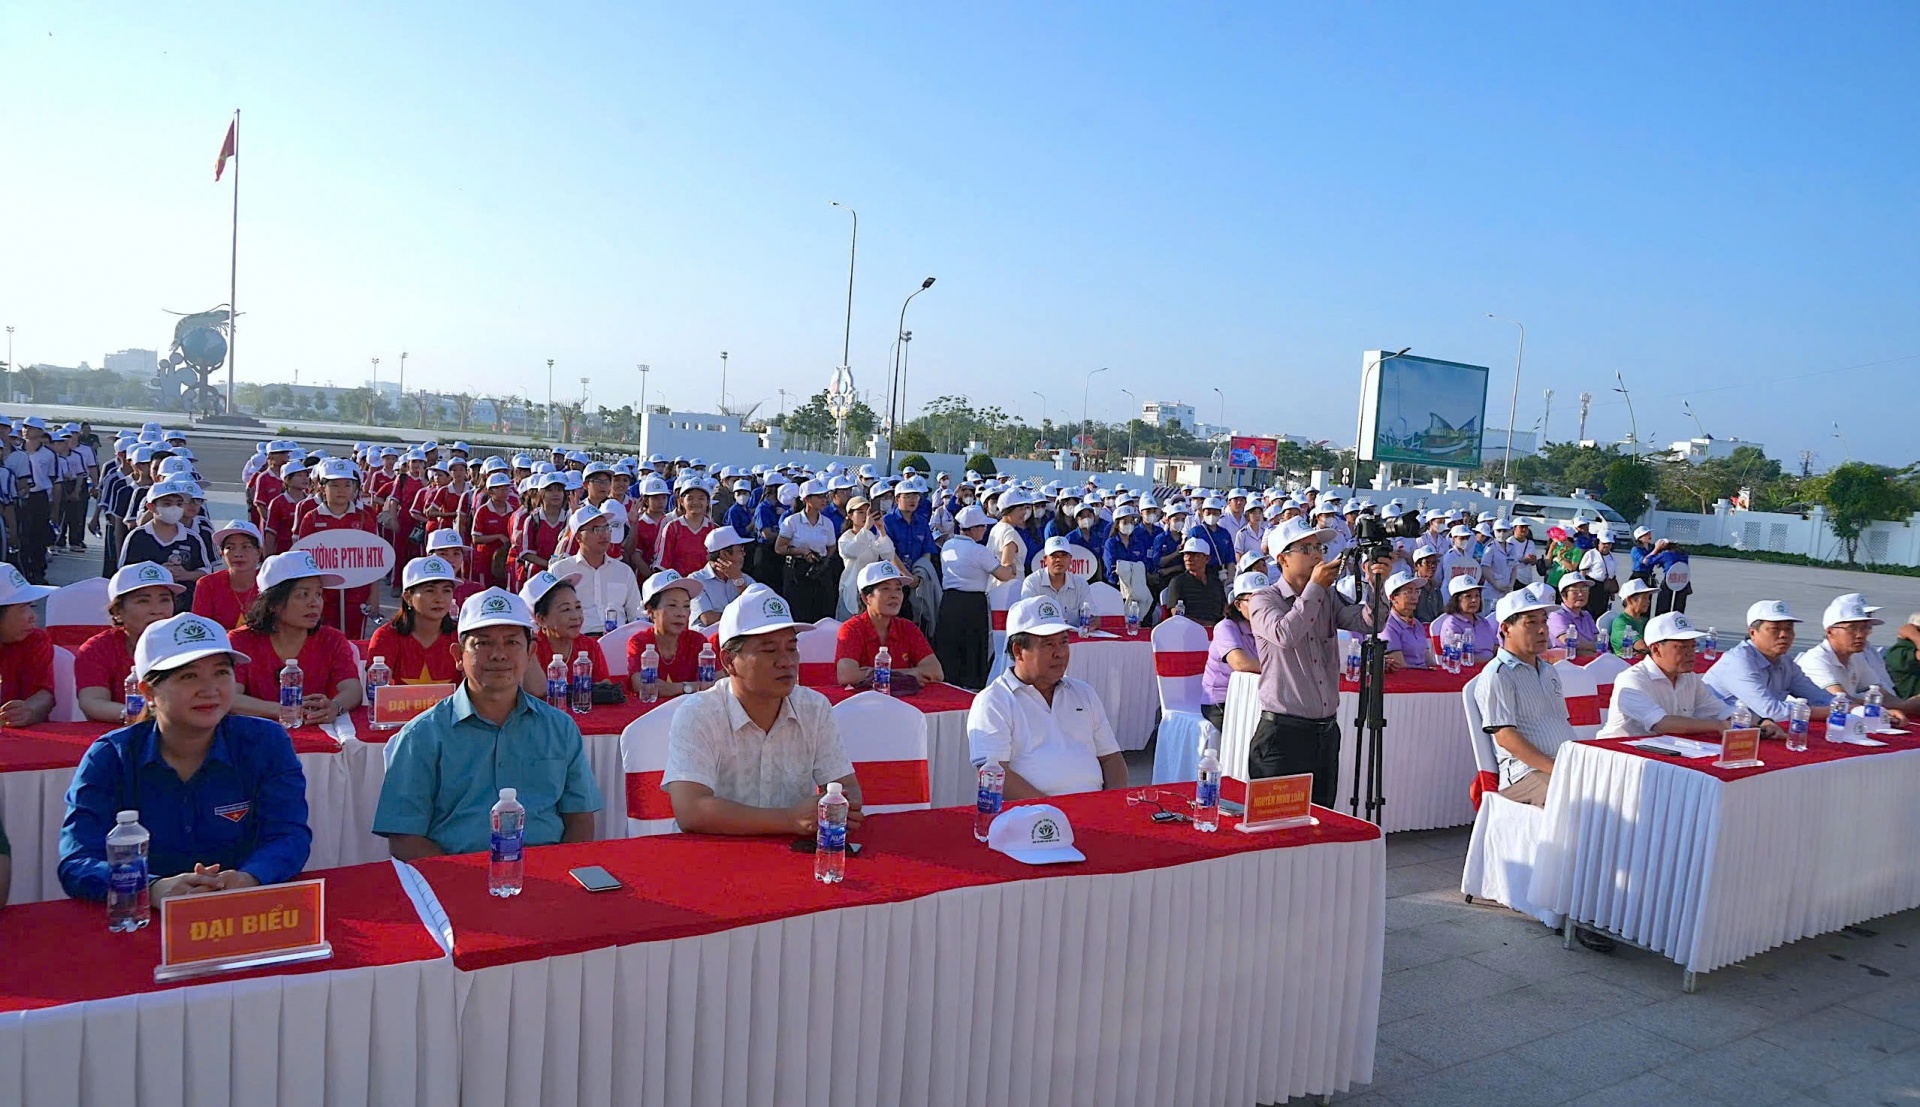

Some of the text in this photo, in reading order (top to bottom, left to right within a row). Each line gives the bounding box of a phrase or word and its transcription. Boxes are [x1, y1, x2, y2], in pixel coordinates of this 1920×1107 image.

[300, 543, 384, 569] ƯỜNG PTTH HTK
[190, 904, 299, 942] ĐẠI BIỂU
